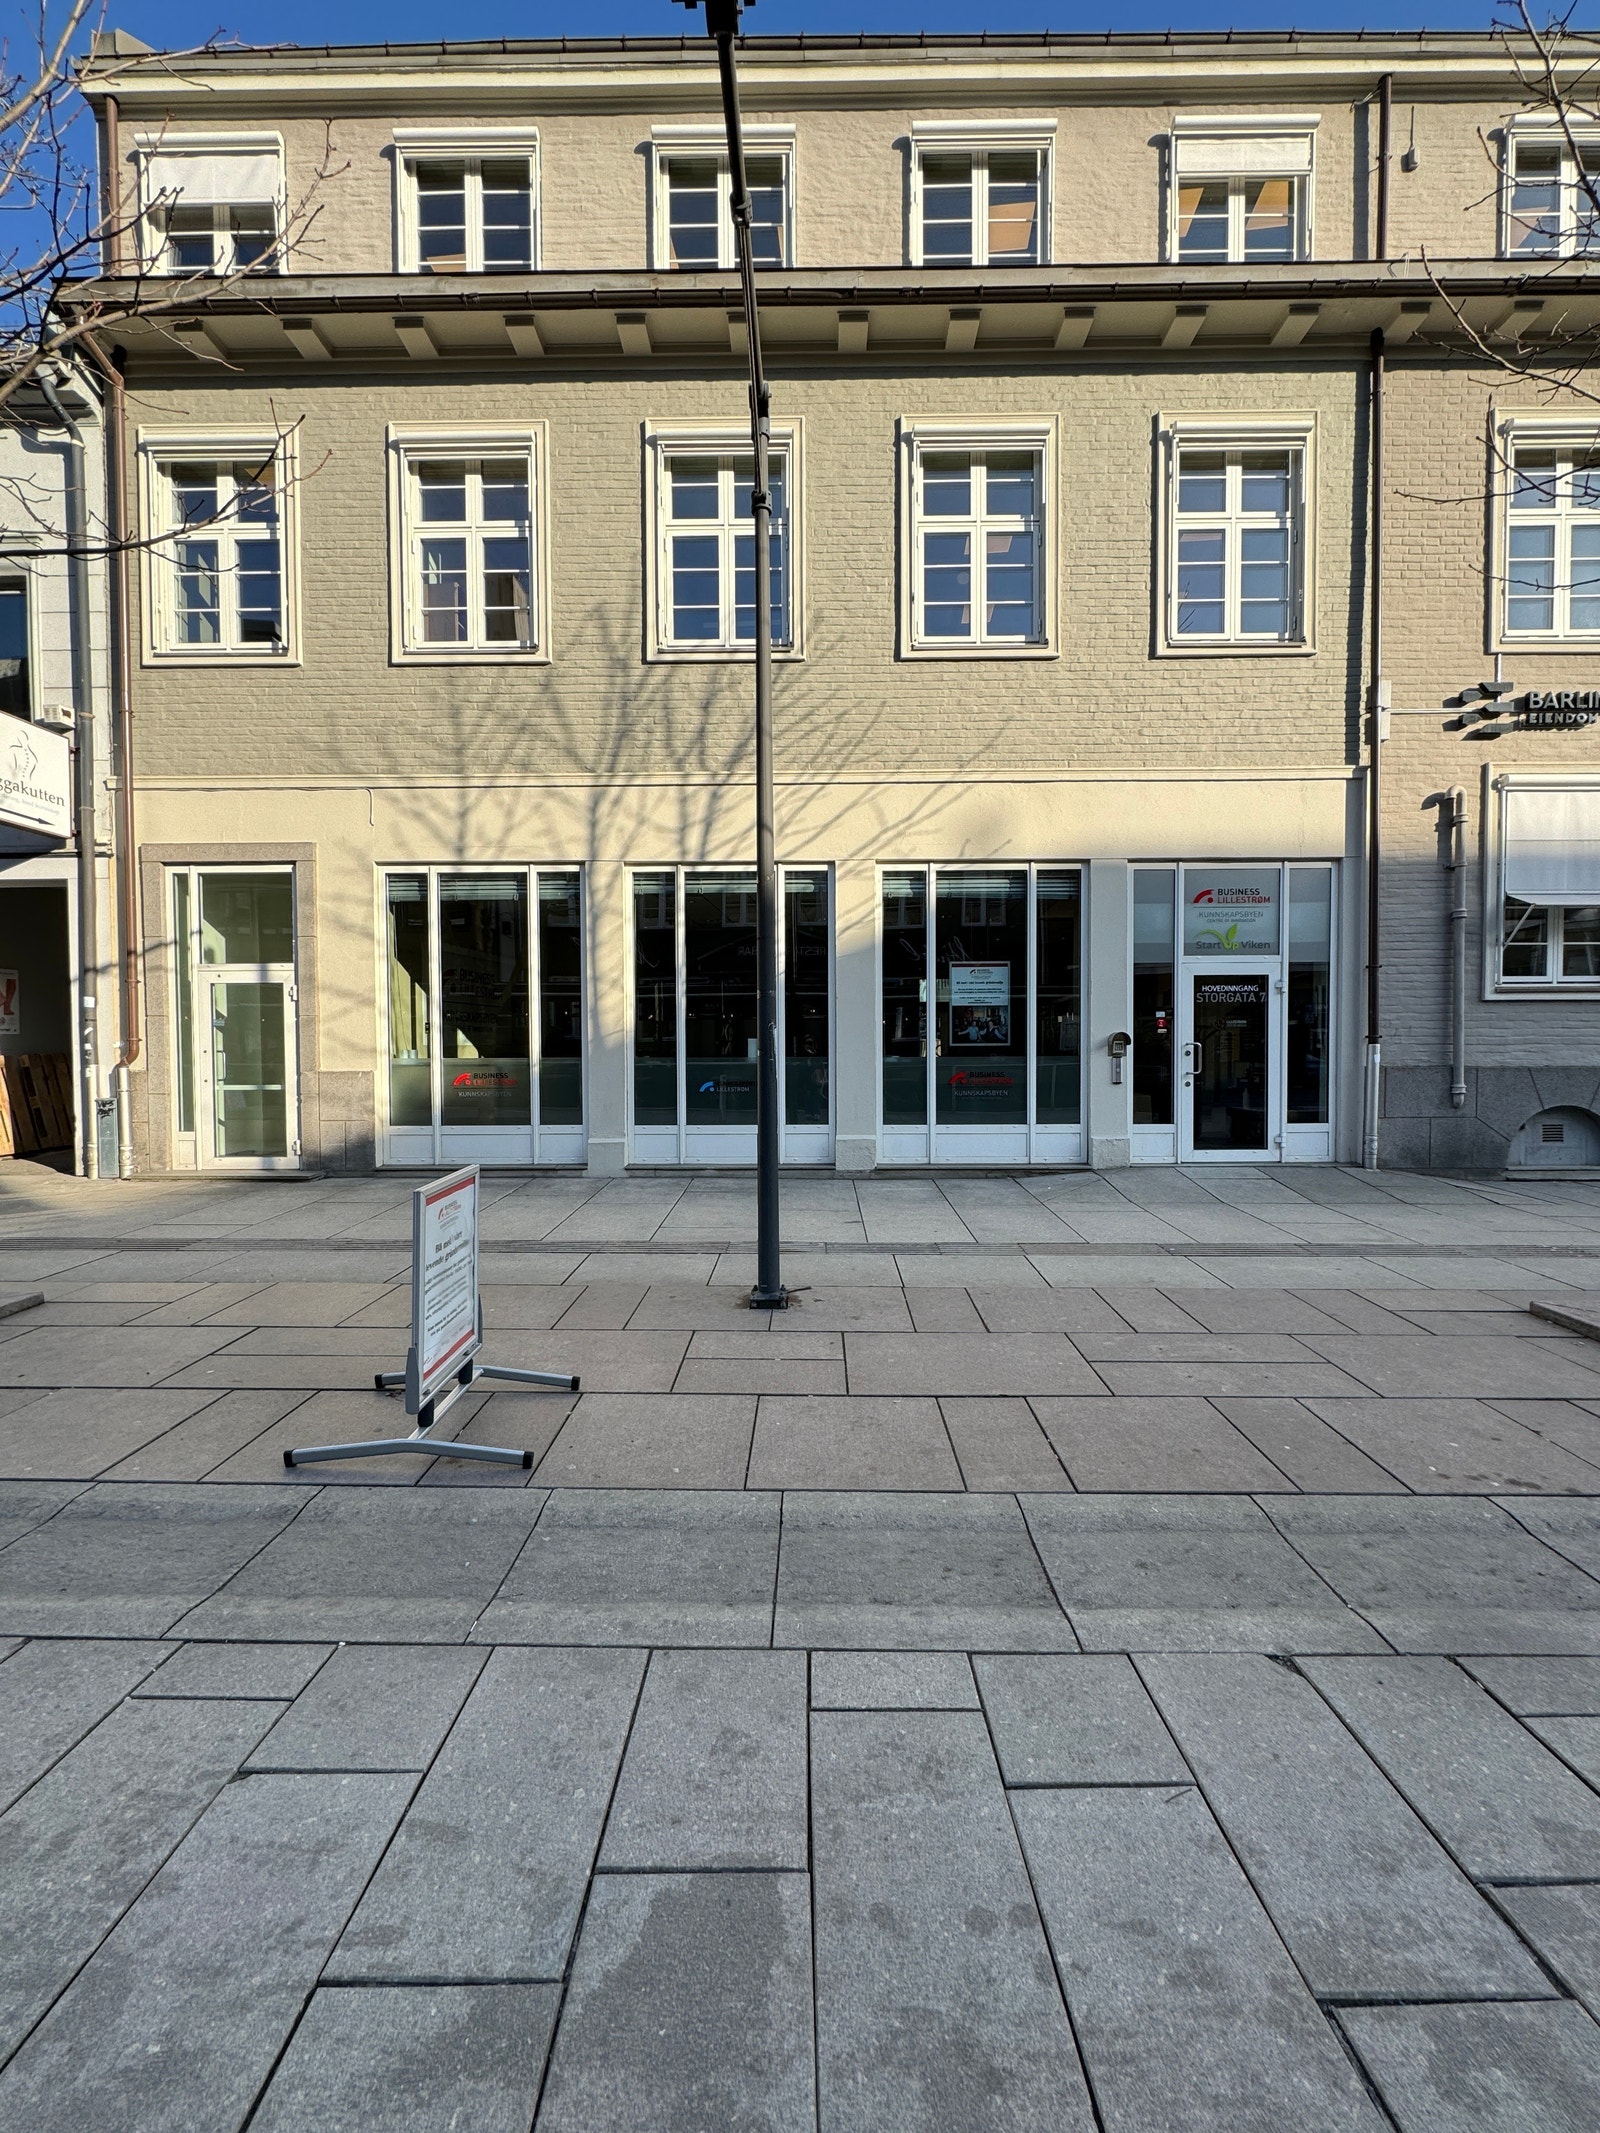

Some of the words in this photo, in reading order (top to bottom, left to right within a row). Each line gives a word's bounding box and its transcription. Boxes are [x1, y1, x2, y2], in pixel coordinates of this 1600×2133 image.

[1529, 713, 1599, 724] EIENDOM
[1217, 888, 1260, 896] BUSINESS
[1217, 896, 1271, 904] LILLESTRØM
[1195, 940, 1221, 950] Start
[1240, 940, 1271, 950] Viken
[1201, 984, 1259, 992] HOVEDINNGANG
[1196, 992, 1257, 1003] STORGATA
[1259, 992, 1267, 1003] 7
